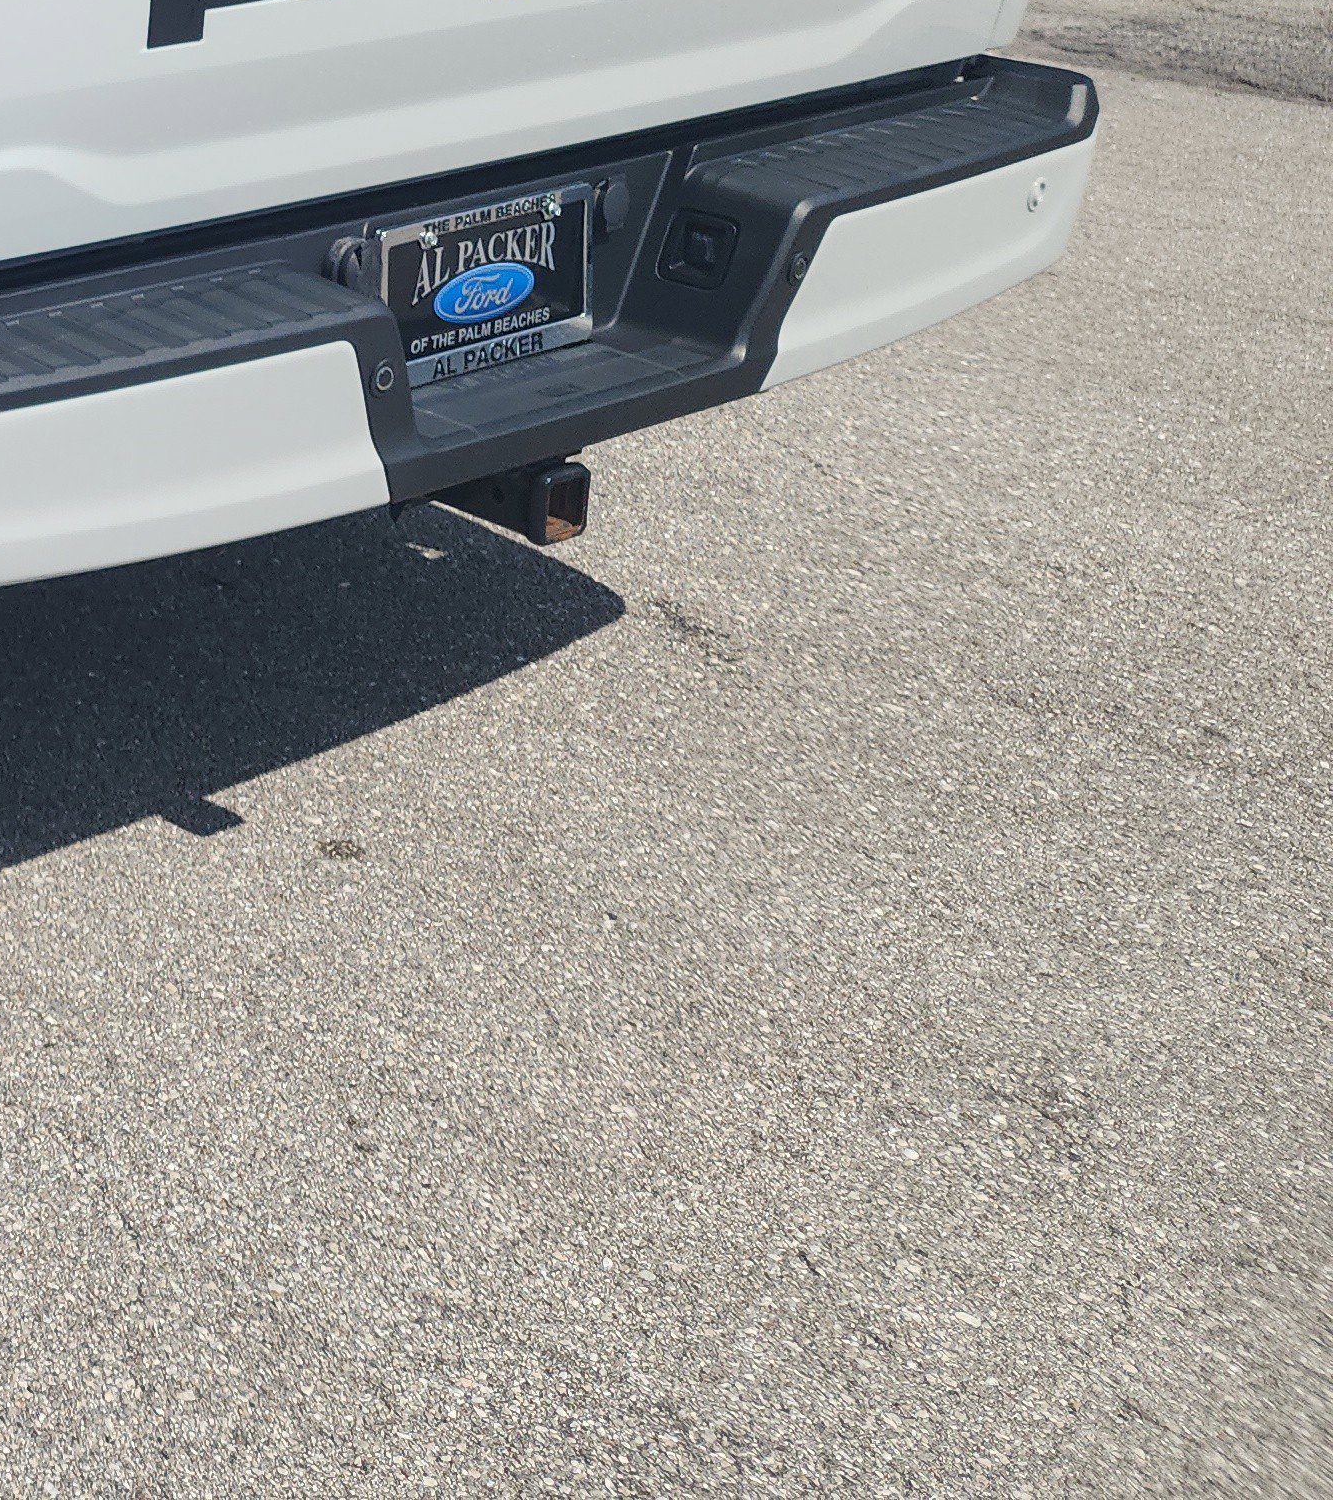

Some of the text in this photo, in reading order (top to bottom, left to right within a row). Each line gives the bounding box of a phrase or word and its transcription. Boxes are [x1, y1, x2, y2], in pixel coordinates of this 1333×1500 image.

[454, 208, 491, 229] PALM
[411, 221, 556, 306] AL PACKER
[454, 273, 514, 314] Ford
[410, 306, 551, 354] OF THE PALM BEACHES
[433, 331, 544, 379] AL PACKER
